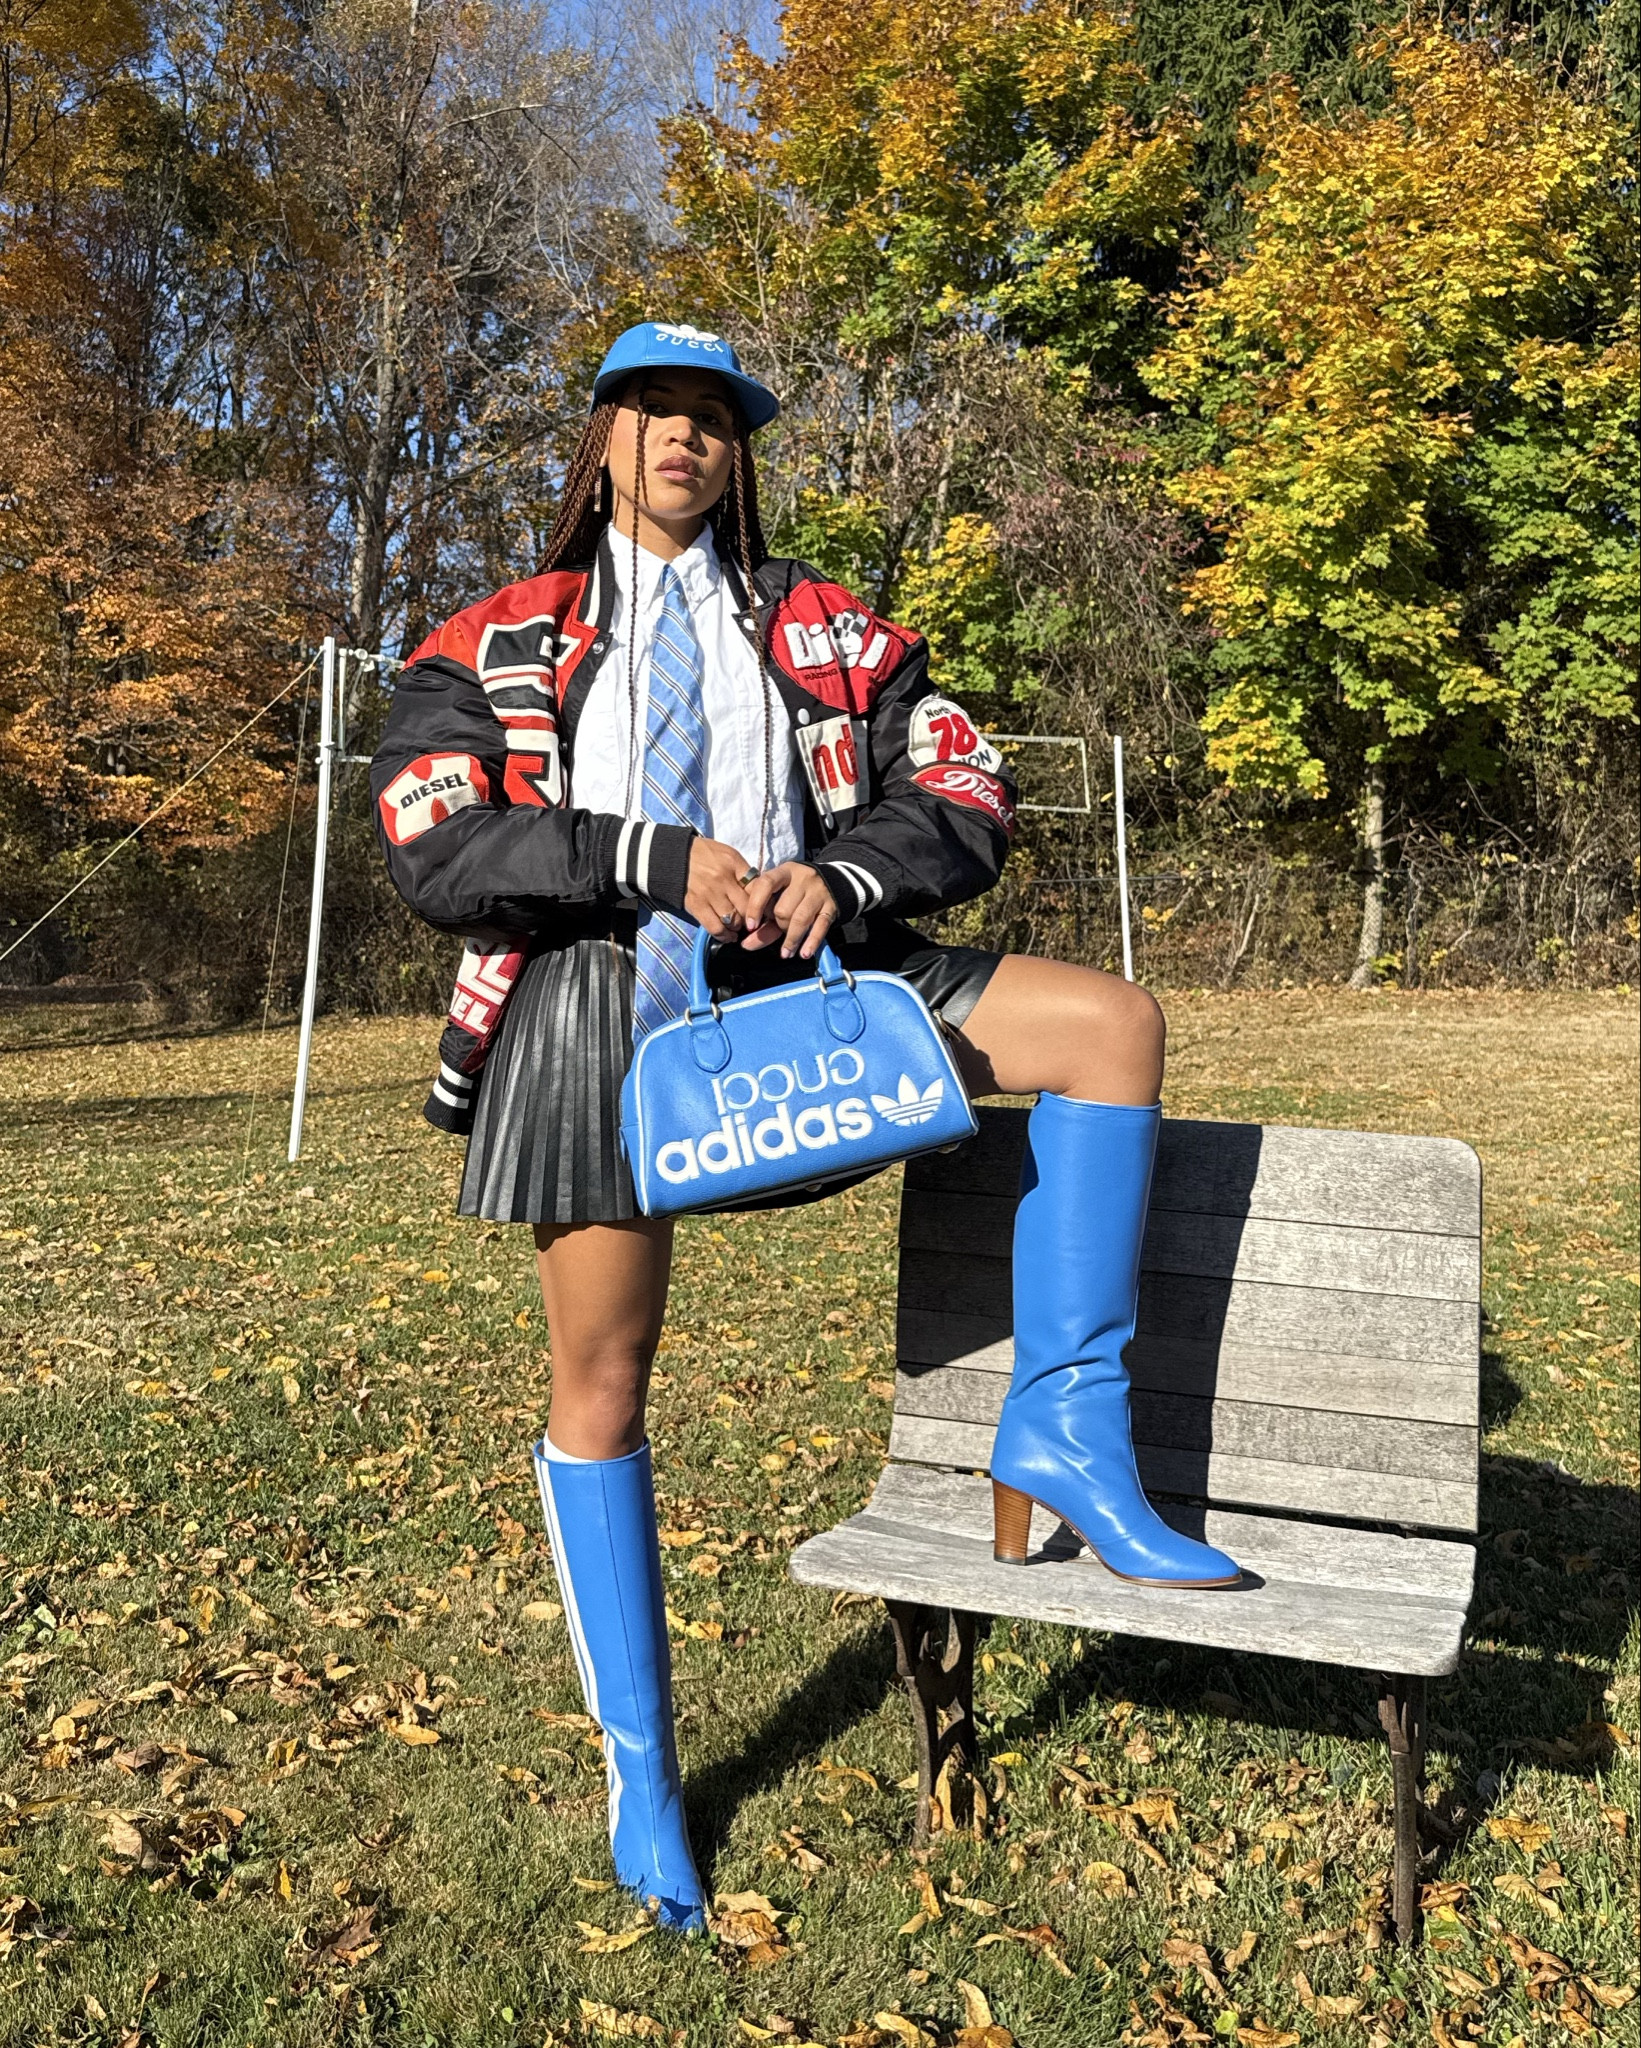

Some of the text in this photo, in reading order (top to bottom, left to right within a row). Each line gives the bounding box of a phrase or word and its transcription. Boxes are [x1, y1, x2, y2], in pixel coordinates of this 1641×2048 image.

[656, 333, 724, 353] GUCCI
[928, 713, 977, 761] 78
[400, 773, 468, 809] DIESEL
[925, 770, 1013, 828] Diesel
[656, 1098, 873, 1184] adidas
